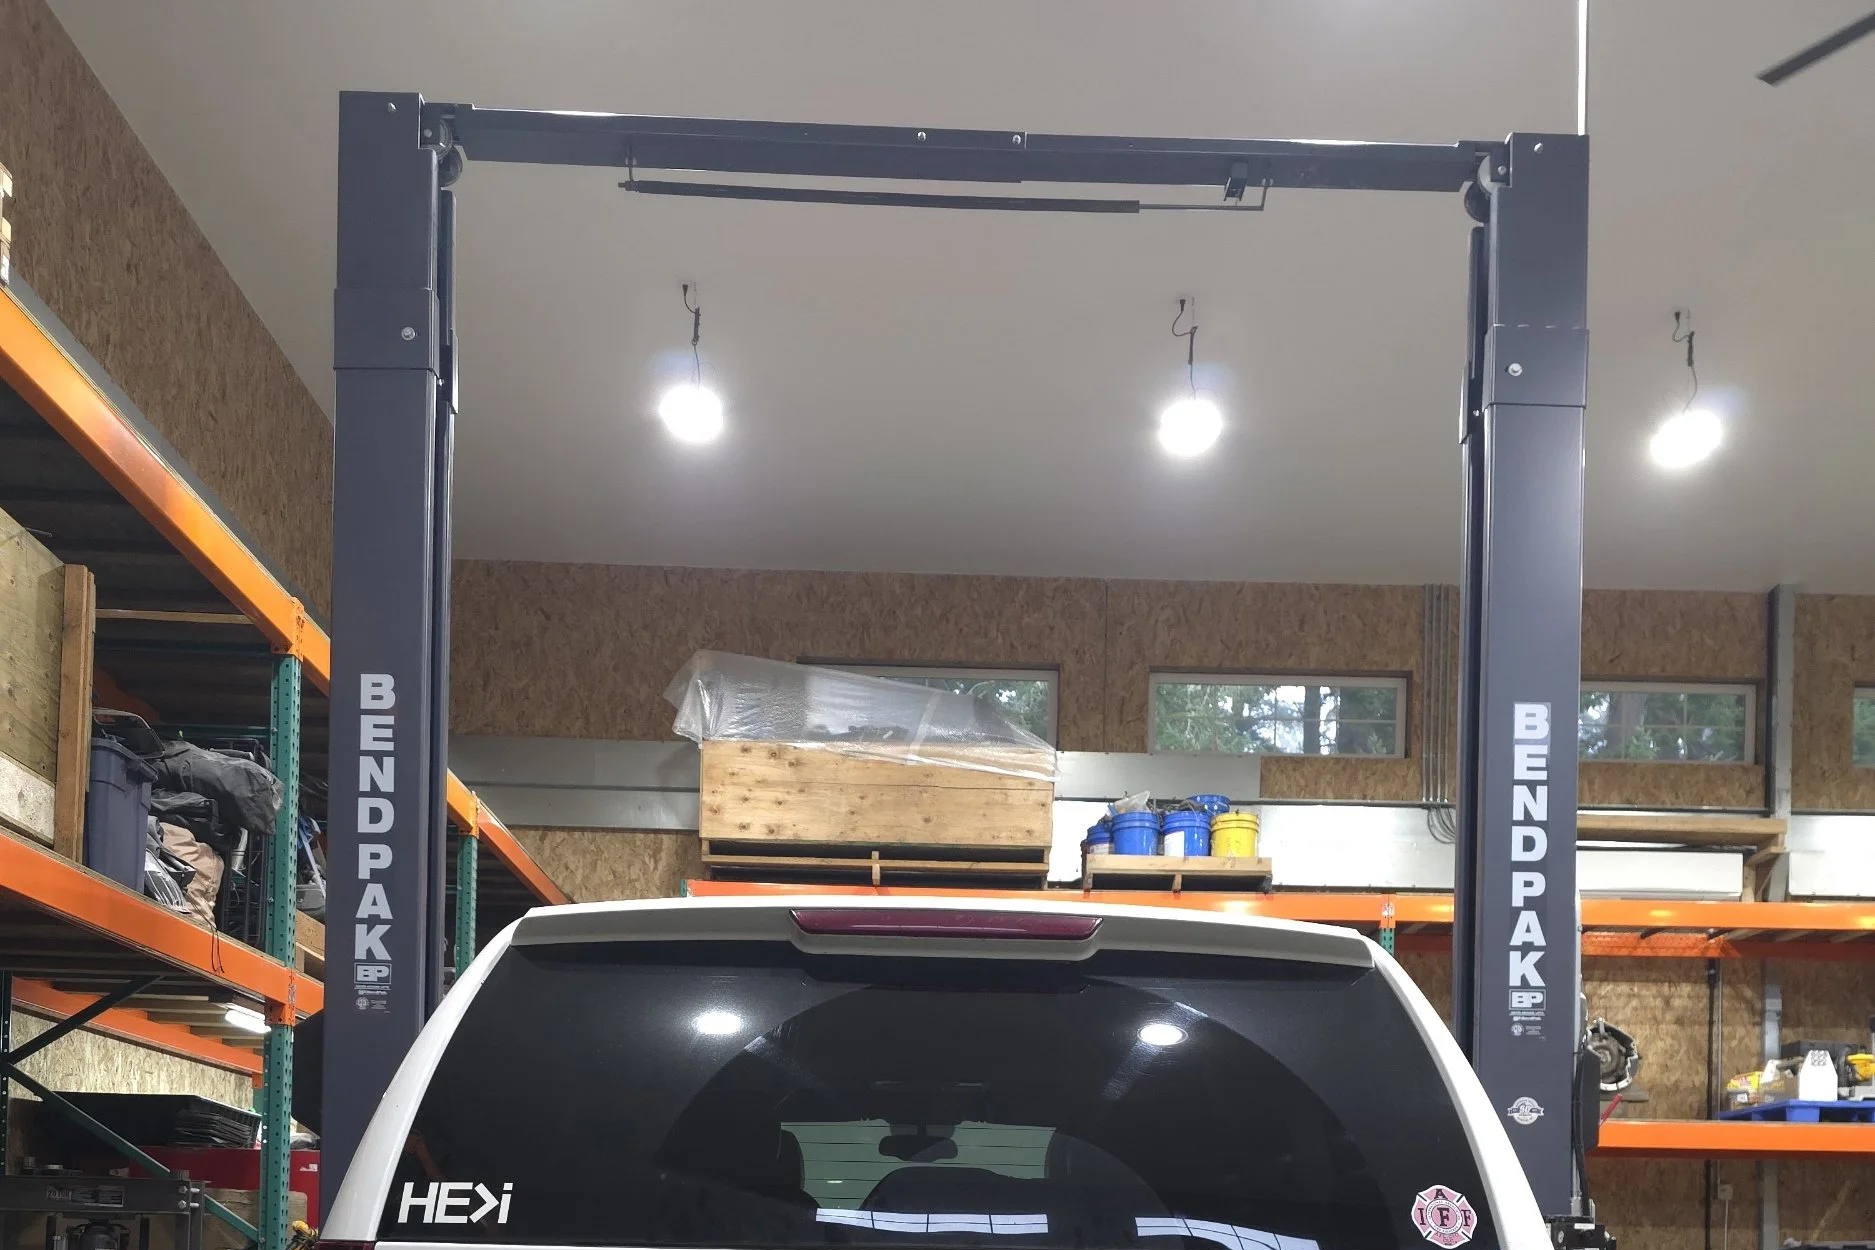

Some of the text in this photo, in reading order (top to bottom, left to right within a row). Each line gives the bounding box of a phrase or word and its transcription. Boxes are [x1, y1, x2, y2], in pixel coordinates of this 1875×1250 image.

[354, 674, 396, 960] BENDPAK
[1509, 703, 1549, 986] BENDPAK
[357, 965, 390, 981] BP
[1511, 992, 1543, 1007] BP
